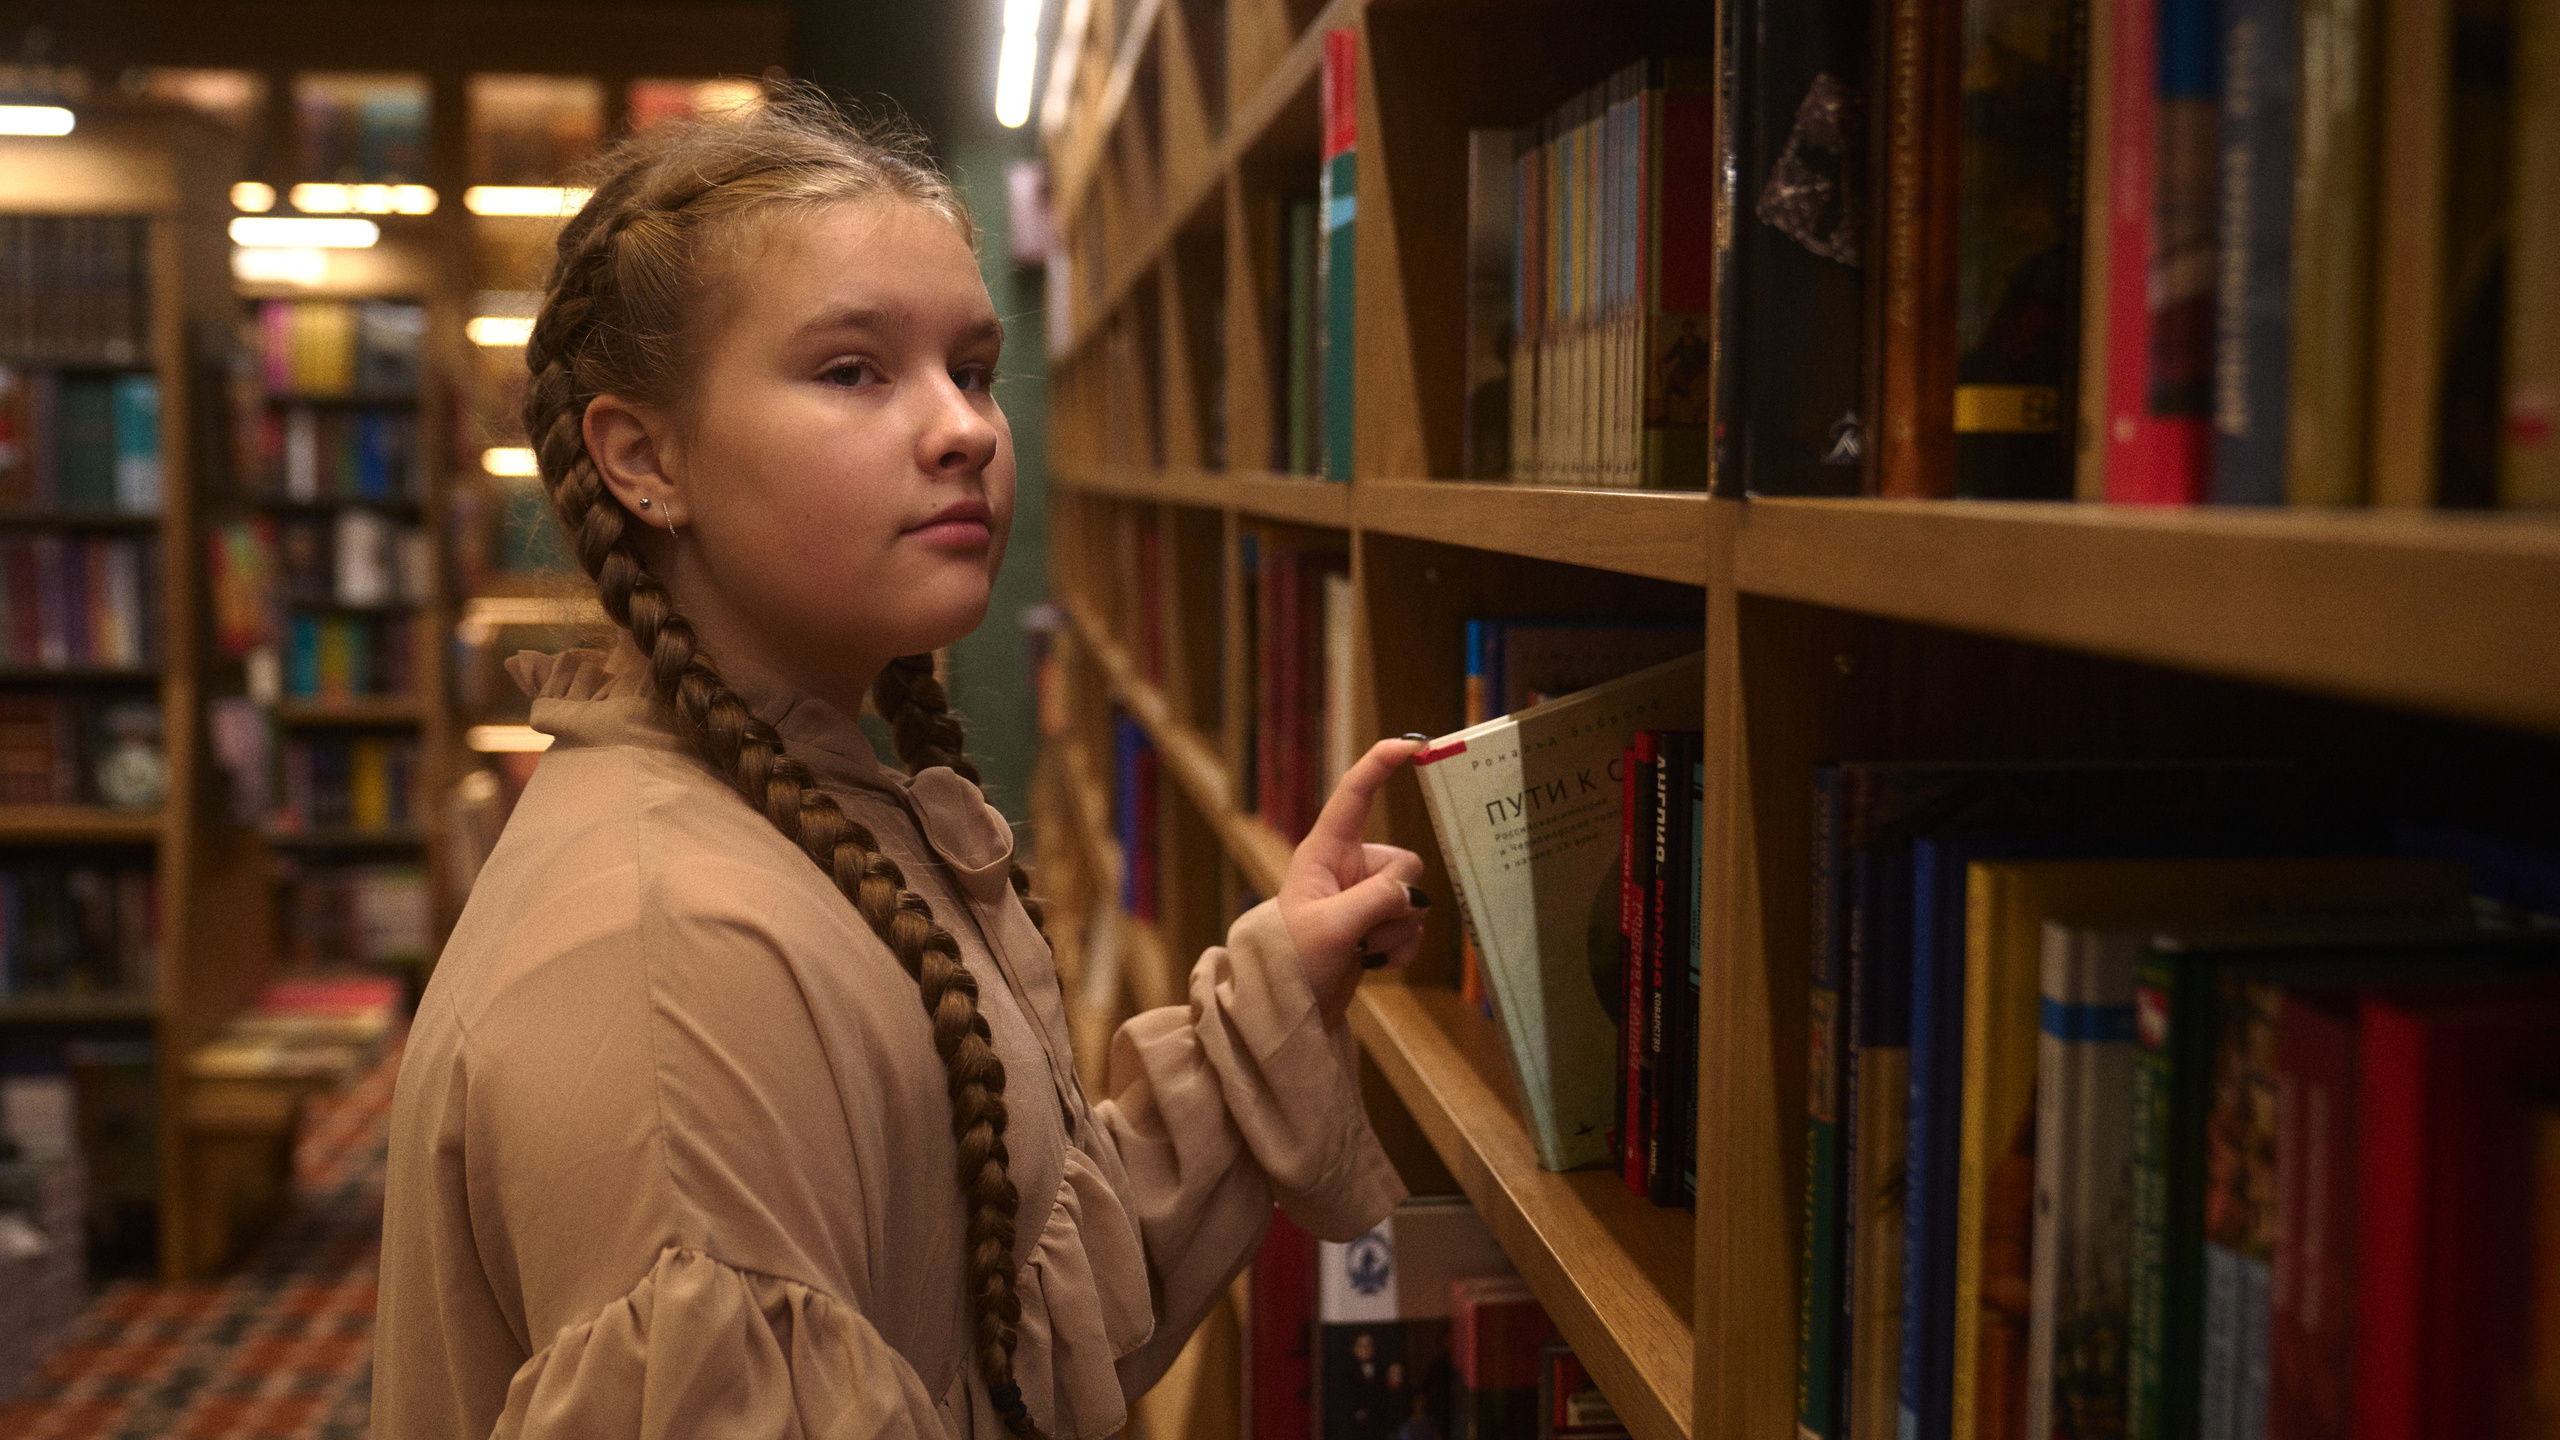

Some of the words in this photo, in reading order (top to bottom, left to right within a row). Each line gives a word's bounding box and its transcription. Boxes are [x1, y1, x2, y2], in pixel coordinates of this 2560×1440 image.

[1485, 778, 1568, 826] ПУТИ
[1577, 768, 1598, 794] К
[1656, 754, 1667, 863] АНГЛИЯ
[1452, 881, 1481, 949] ПУТИ
